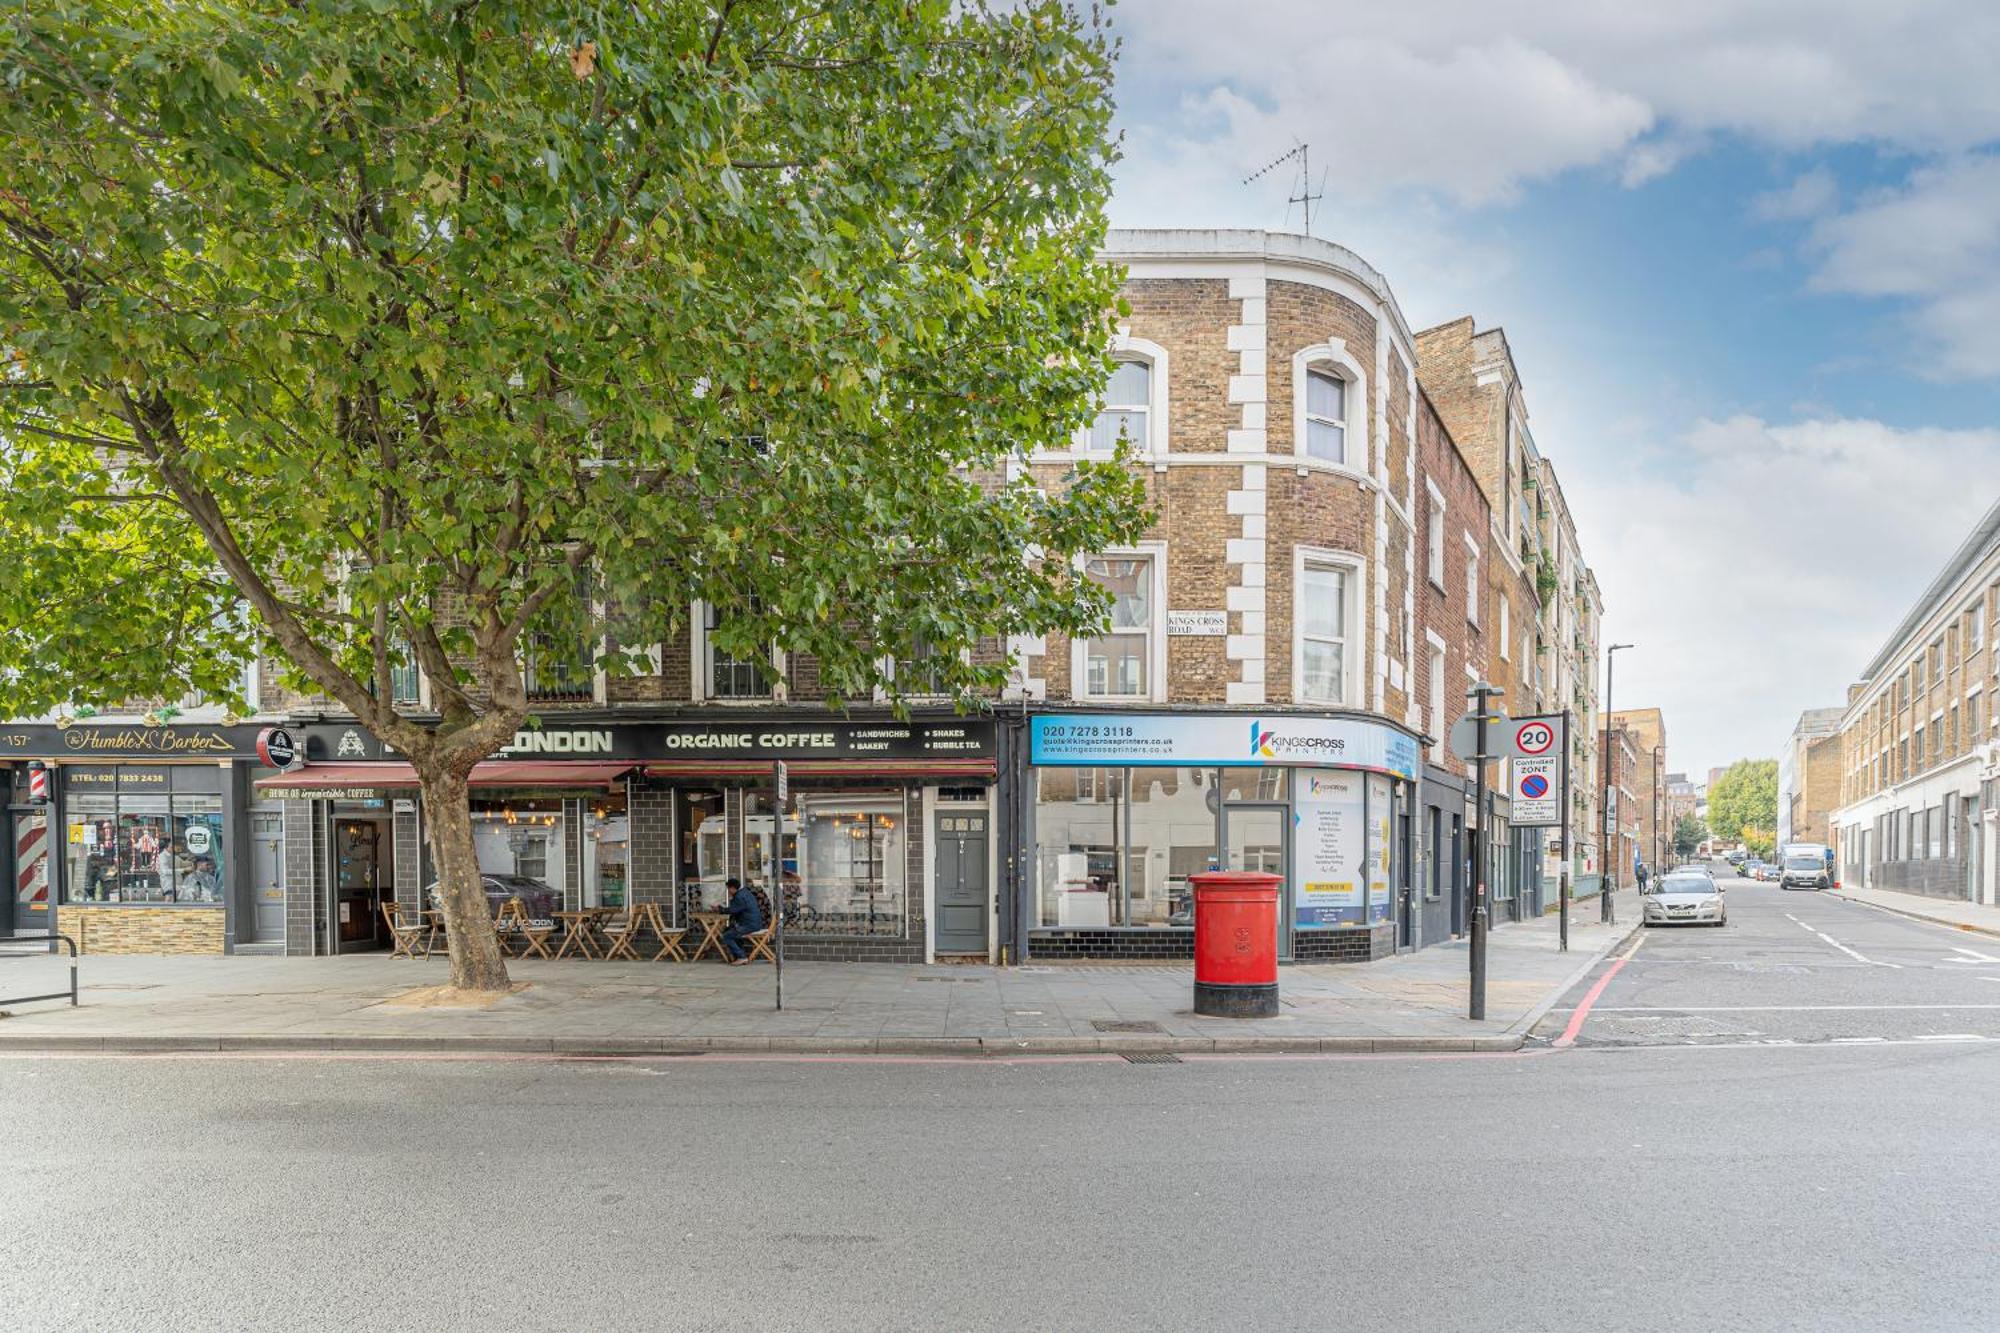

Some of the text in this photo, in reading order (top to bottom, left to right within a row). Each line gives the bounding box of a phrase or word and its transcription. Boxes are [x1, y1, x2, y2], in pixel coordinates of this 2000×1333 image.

[1168, 616, 1224, 626] KINGS CROSS
[1168, 626, 1192, 634] ROAD
[856, 729, 910, 738] SANDWICHES
[931, 729, 965, 738] SHAKES
[1043, 726, 1133, 737] 020 7278 3118
[66, 729, 137, 749] Humble
[666, 732, 836, 749] ORGANIC COFFEE
[1270, 736, 1345, 749] KINGSCROSS
[1522, 731, 1548, 745] 20
[856, 741, 889, 750] BAKERY
[932, 741, 981, 750] BUBBLE TEA
[1043, 745, 1173, 754] www.kingscrossprinters.co.uk
[1275, 747, 1344, 756] PRINTERS
[1515, 758, 1554, 766] Controlled
[1520, 765, 1548, 774] ZONE
[98, 774, 114, 783] 020
[268, 788, 289, 798] HOME
[290, 788, 299, 798] OF
[347, 788, 374, 798] COFFEE
